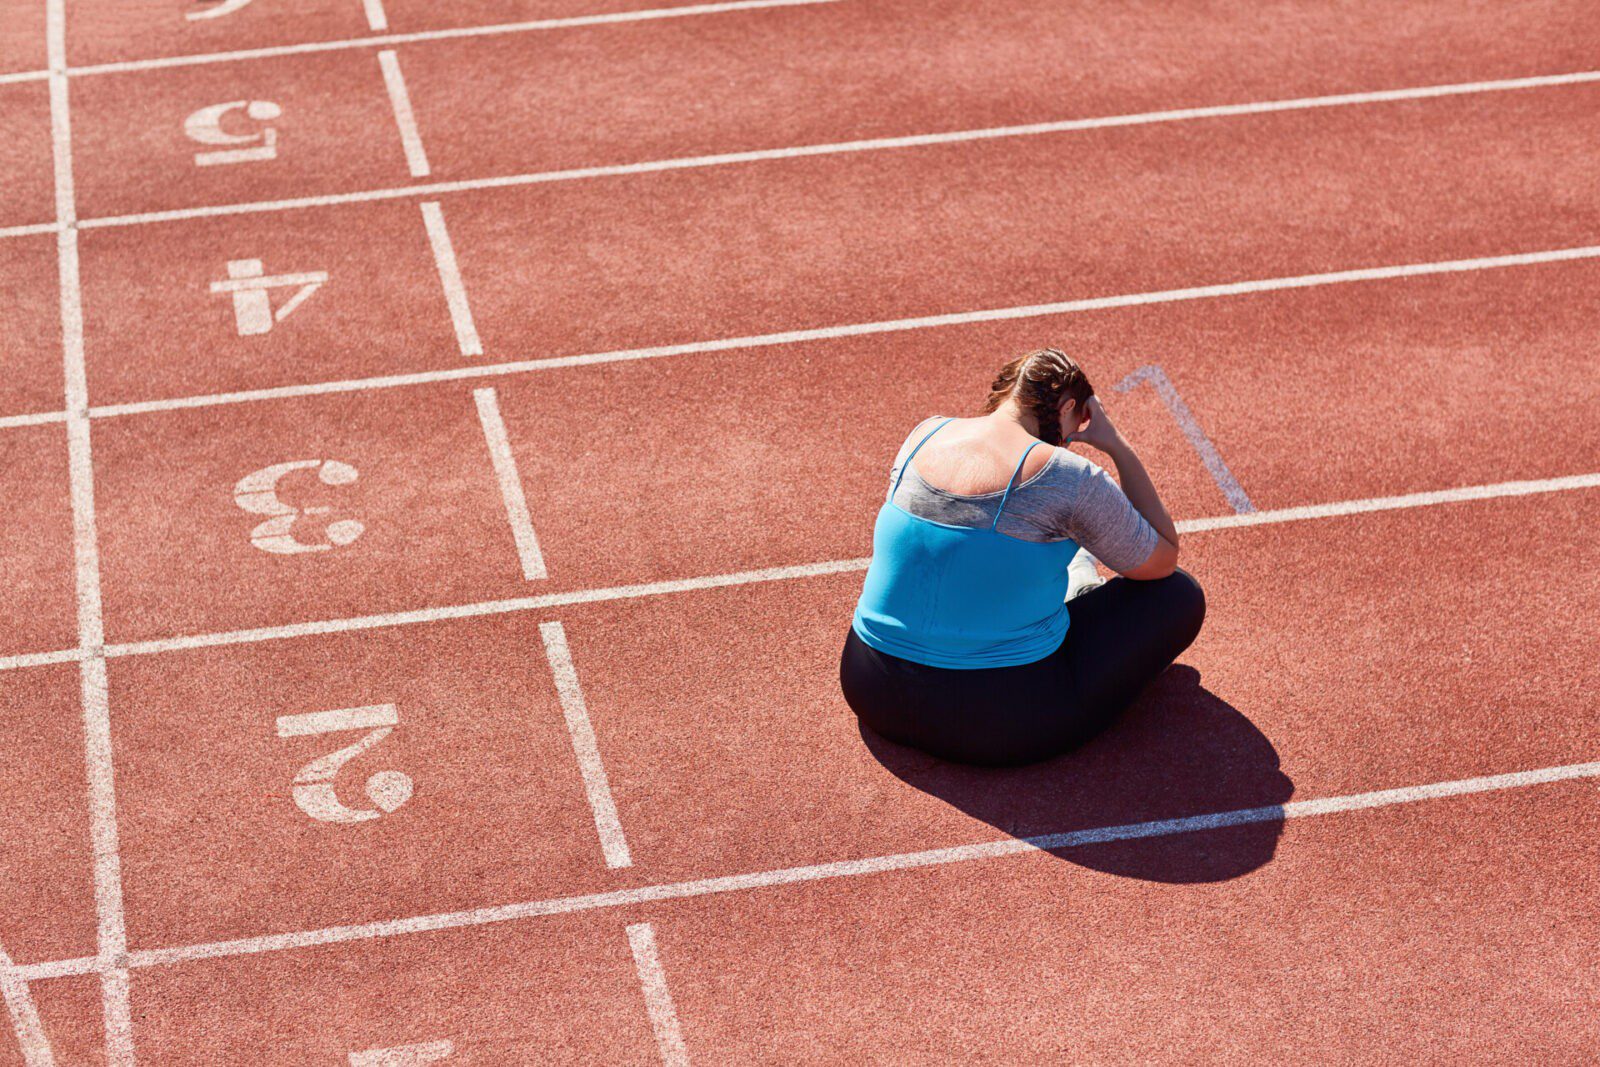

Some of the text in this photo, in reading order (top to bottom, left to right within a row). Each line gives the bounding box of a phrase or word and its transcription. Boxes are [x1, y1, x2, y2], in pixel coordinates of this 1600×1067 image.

[184, 101, 282, 165] 5
[210, 259, 328, 335] 4
[235, 460, 364, 554] 3
[276, 704, 412, 822] 2
